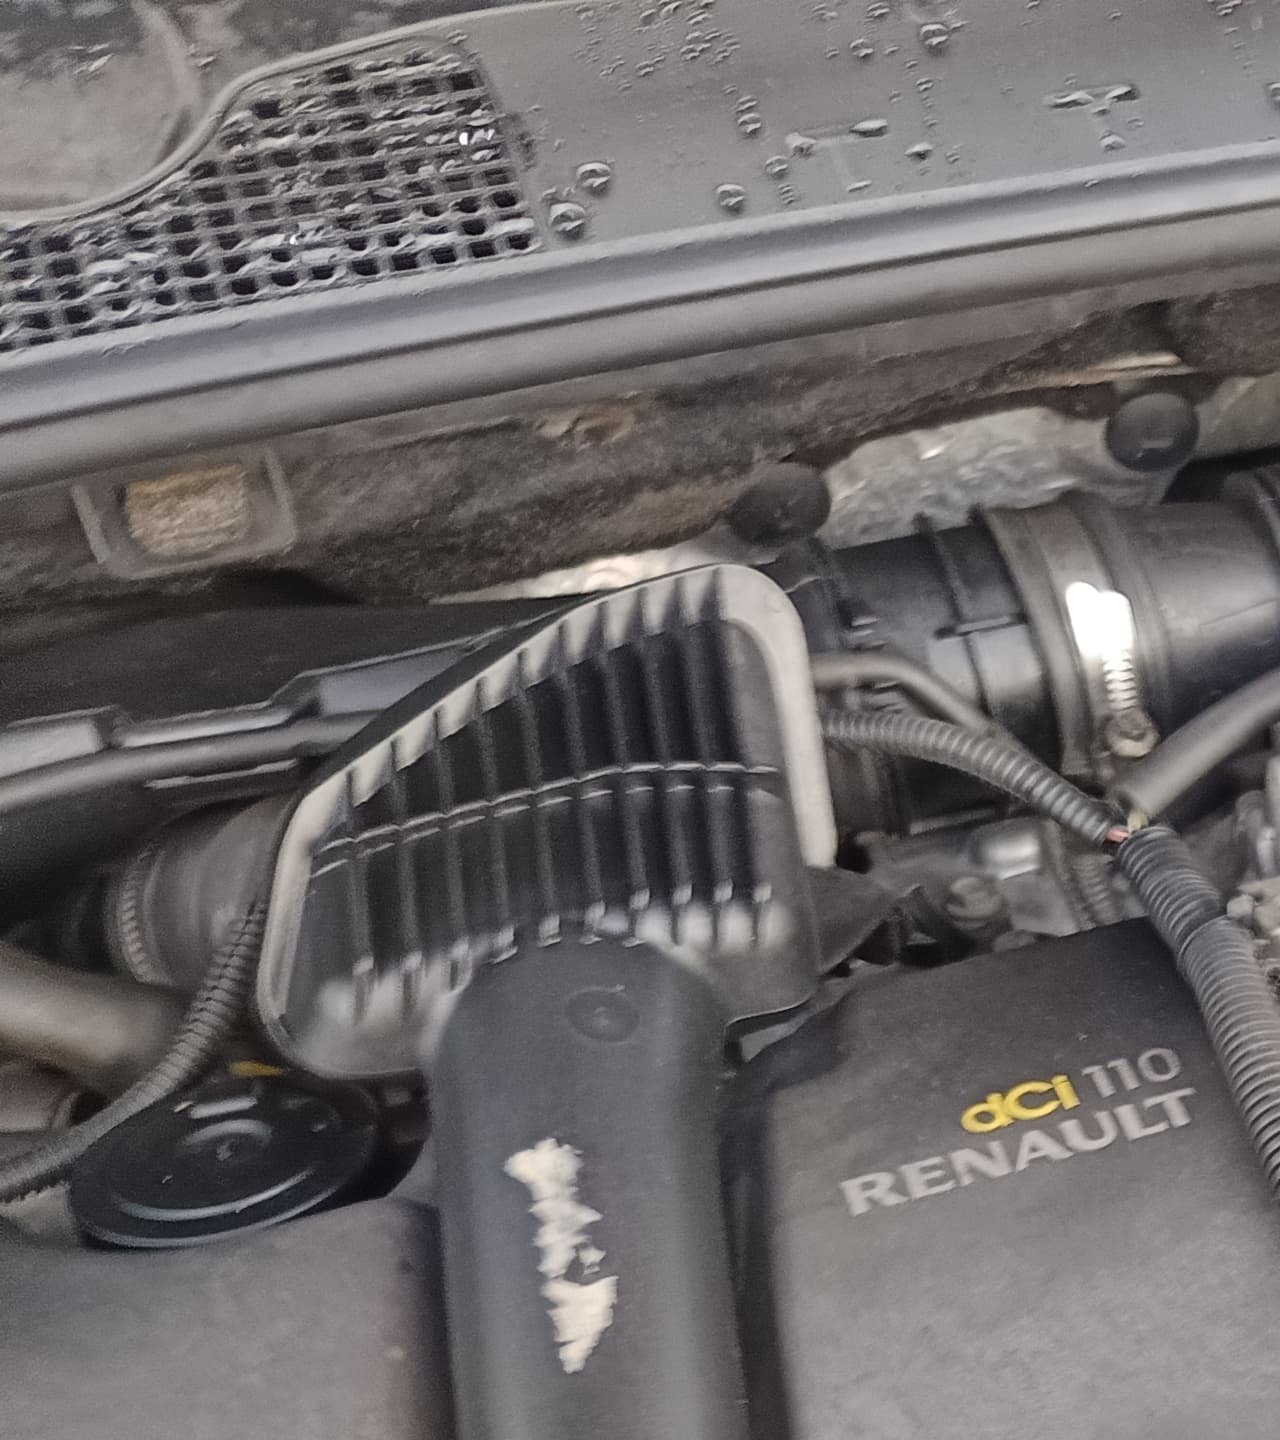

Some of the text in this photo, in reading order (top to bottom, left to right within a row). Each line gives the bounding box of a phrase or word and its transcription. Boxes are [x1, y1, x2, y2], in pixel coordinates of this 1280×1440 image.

[960, 1047, 1183, 1133] dCi 110
[839, 1086, 1198, 1217] RENAULT
